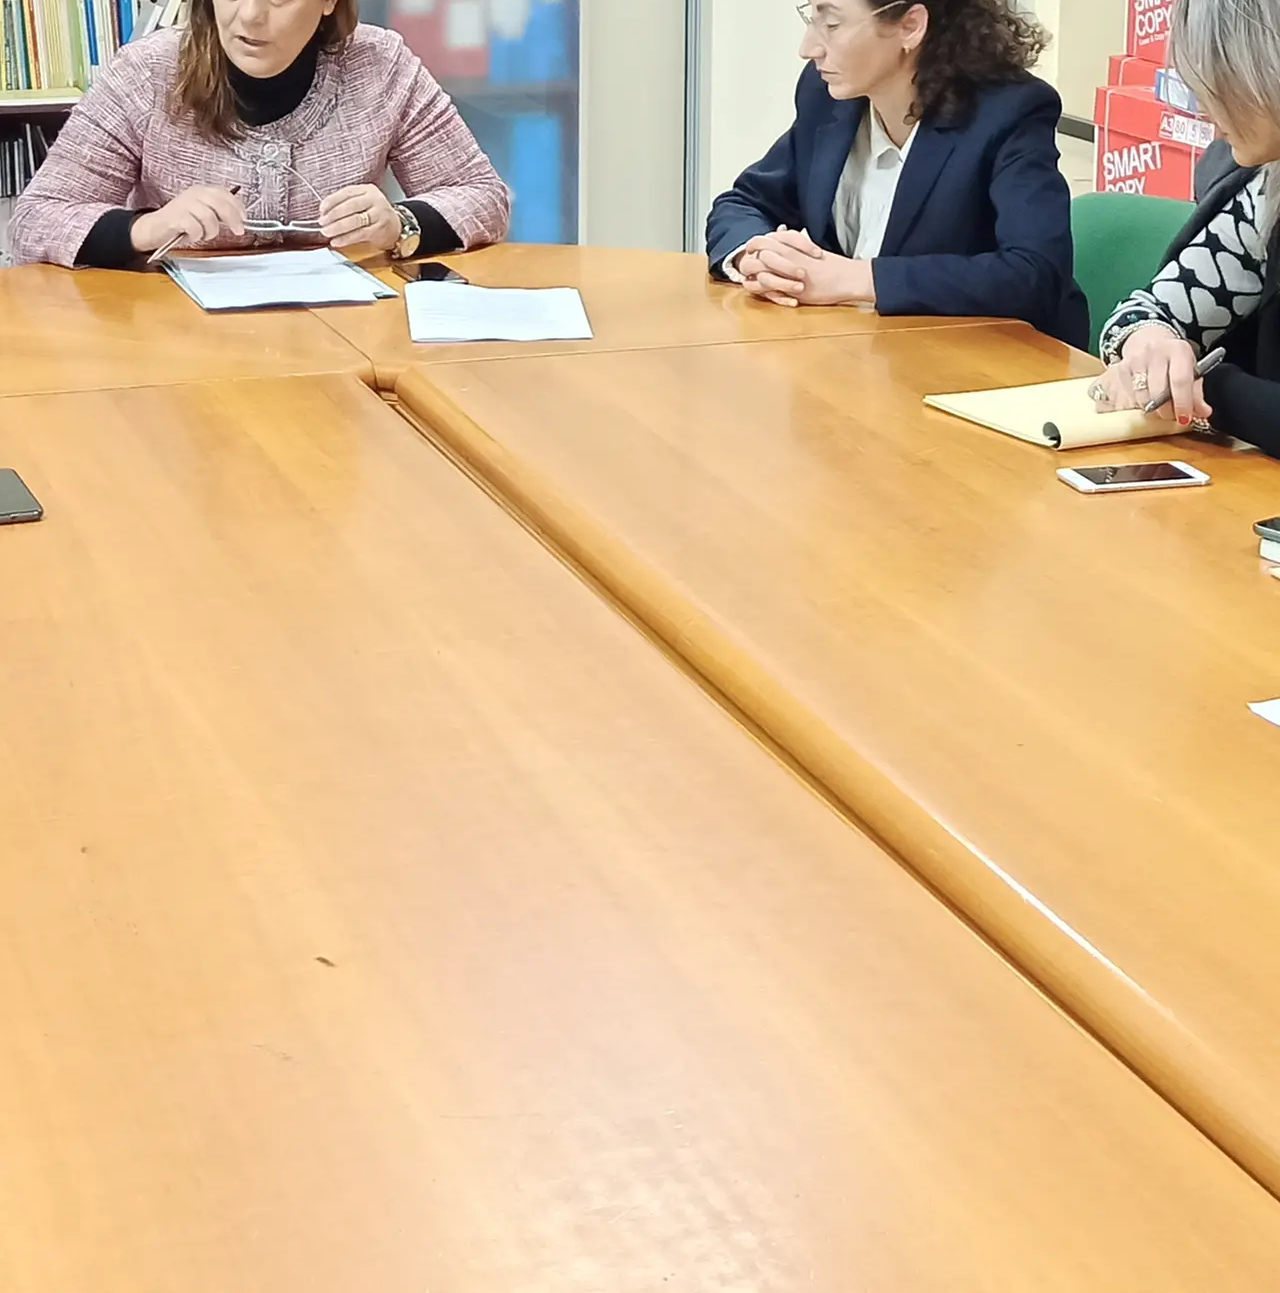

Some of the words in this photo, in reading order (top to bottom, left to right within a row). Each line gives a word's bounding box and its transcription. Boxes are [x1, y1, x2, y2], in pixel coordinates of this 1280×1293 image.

[1136, 3, 1173, 37] COPY
[1161, 115, 1173, 131] A3
[1174, 120, 1185, 134] 80
[1191, 123, 1197, 137] 5
[1103, 141, 1162, 181] SMART
